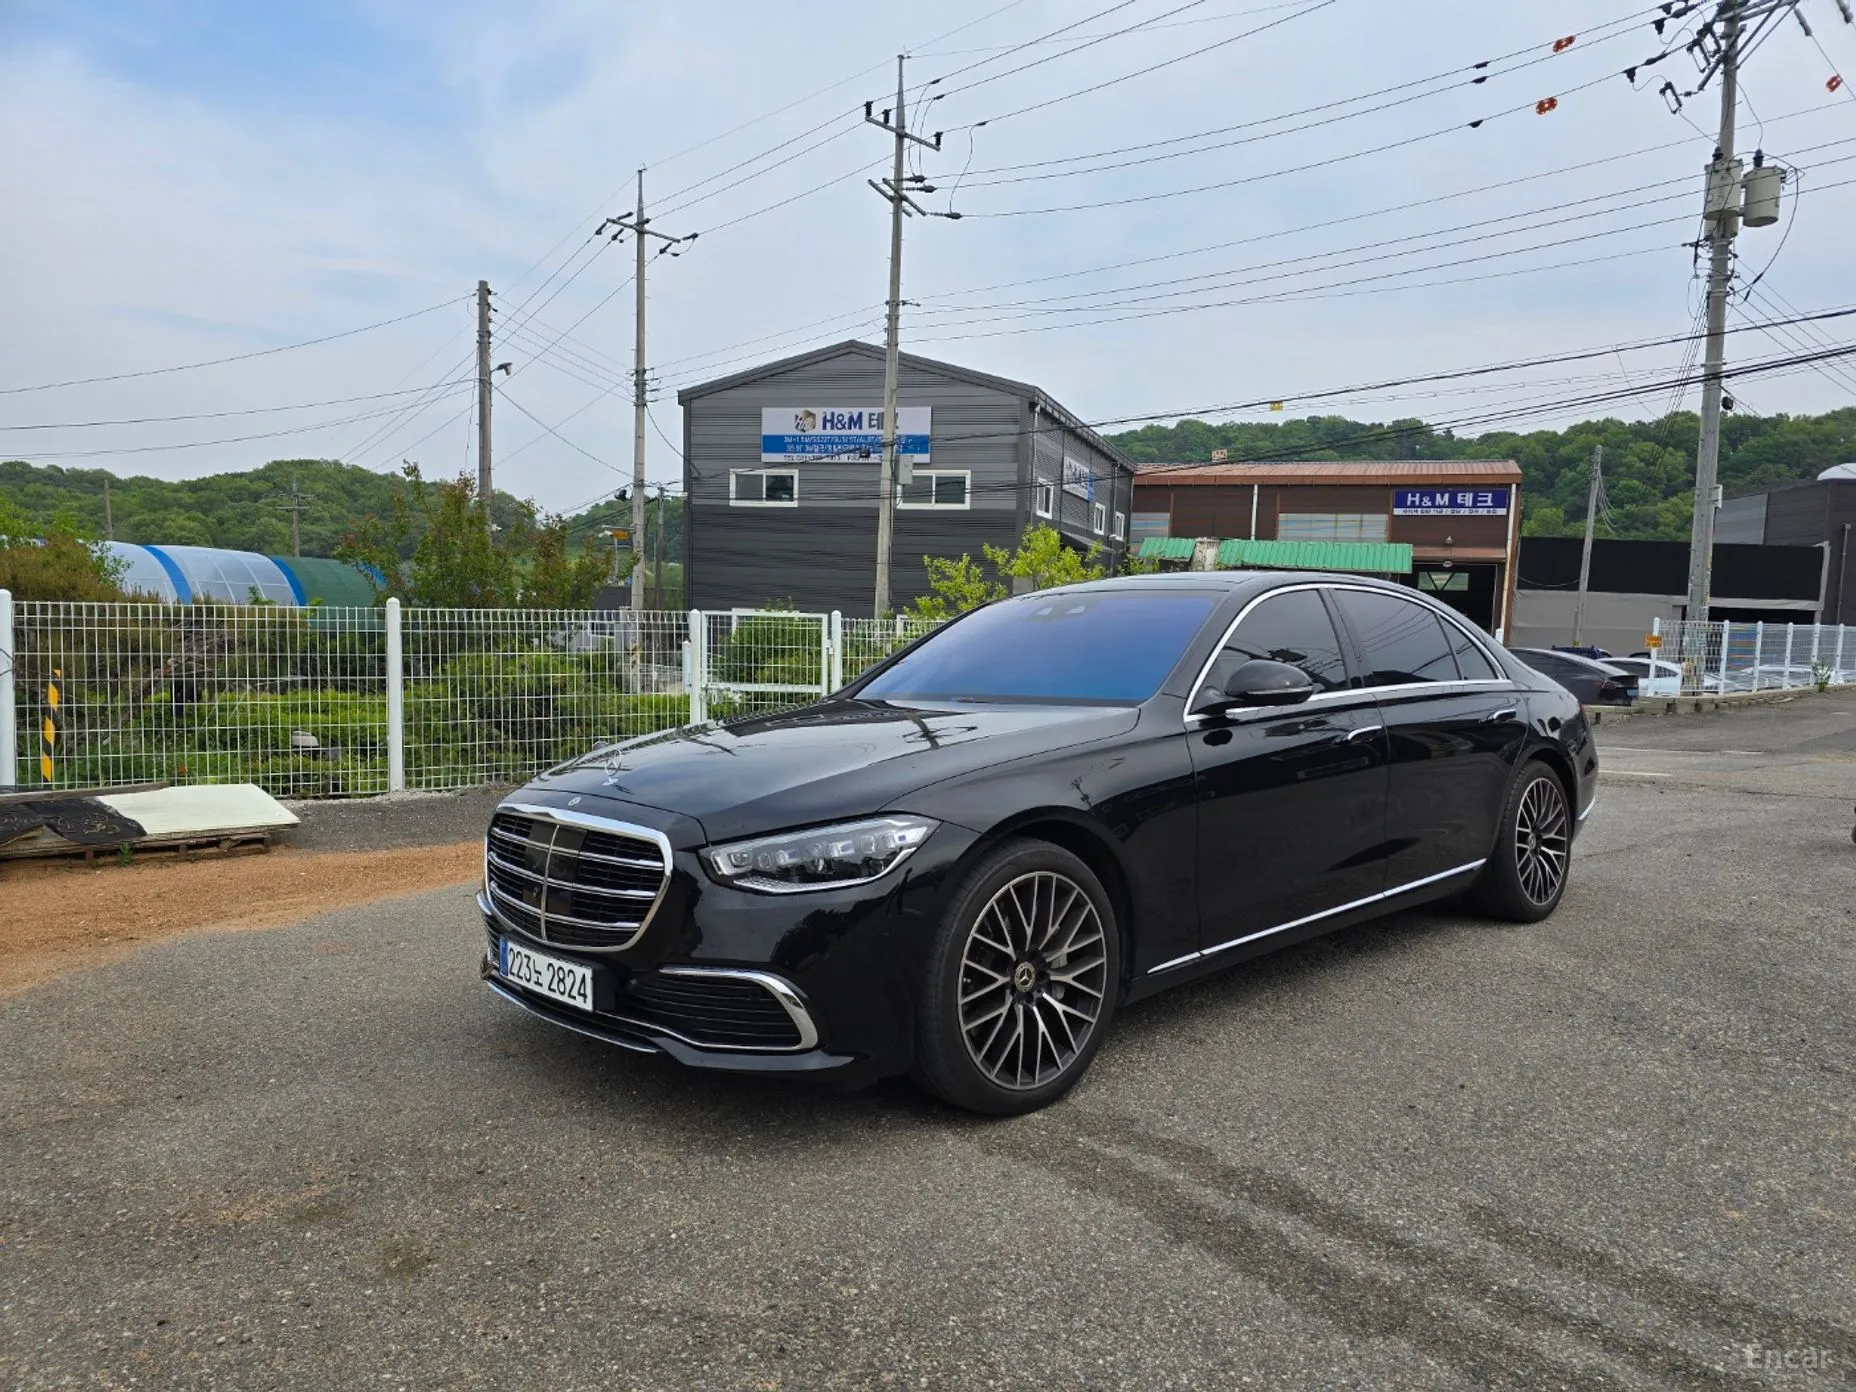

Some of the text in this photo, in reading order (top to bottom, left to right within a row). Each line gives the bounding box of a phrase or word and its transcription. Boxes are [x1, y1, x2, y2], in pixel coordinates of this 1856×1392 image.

[821, 411, 863, 431] H&M
[1406, 492, 1494, 507] H&M 테크
[509, 947, 588, 1004] 223노 2824
